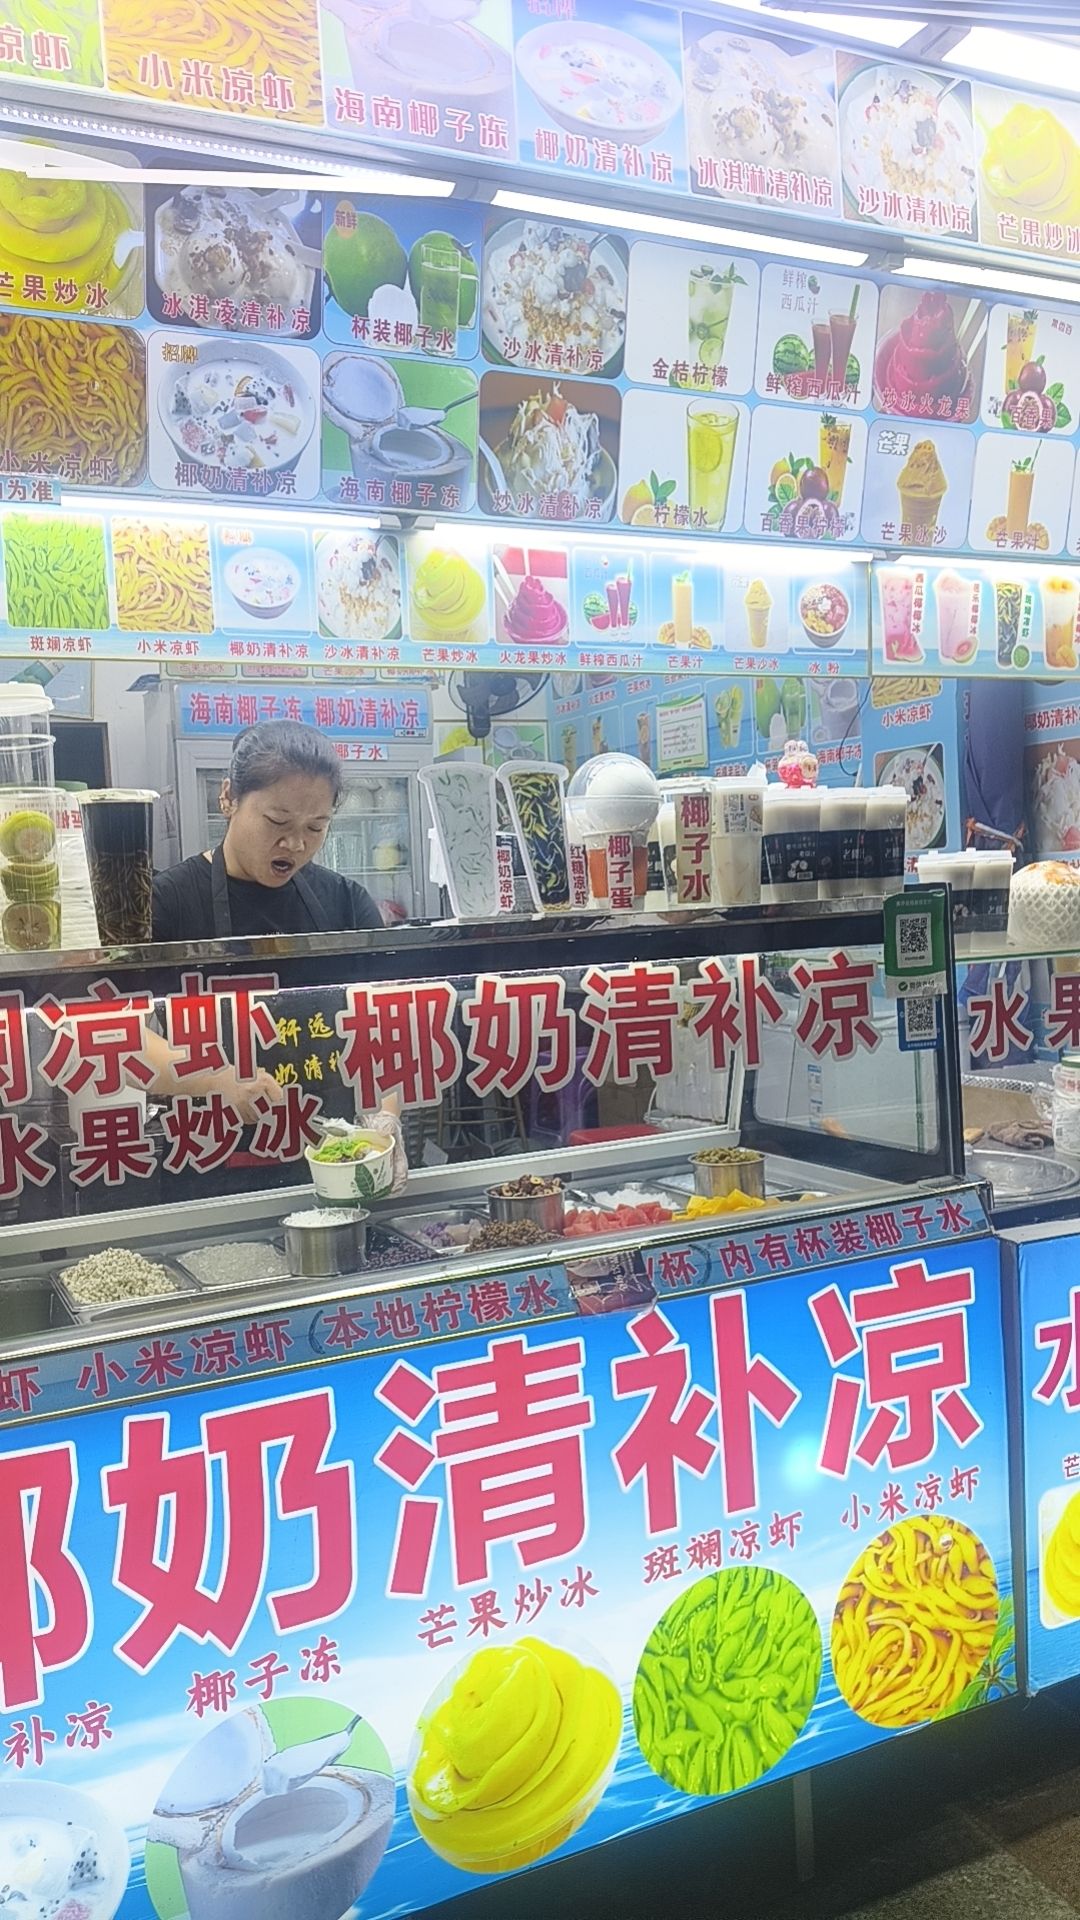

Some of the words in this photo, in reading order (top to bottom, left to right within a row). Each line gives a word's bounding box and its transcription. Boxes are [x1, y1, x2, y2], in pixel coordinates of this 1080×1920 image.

[139, 54, 295, 112] 小米凉虾
[334, 87, 510, 151] 海南椰子冻
[534, 127, 674, 184] 椰奶清补凉
[697, 156, 833, 208] 冰淇淋清补凉
[858, 185, 972, 233] 沙冰清补凉
[0, 271, 109, 309] 芒果炒冰
[781, 293, 818, 315] 西瓜汁
[162, 292, 312, 333] 冰淇凌清补凉
[352, 315, 454, 350] 杯装椰子水
[162, 342, 198, 364] 招牌
[503, 337, 605, 371] 沙冰清补凉
[652, 357, 729, 388] 金桔柠檬
[765, 371, 861, 404] 鲜榨西瓜汁
[882, 387, 970, 419] 炒冰火龙果
[1010, 404, 1054, 428] 百香果
[877, 430, 911, 456] 芒果
[0, 449, 114, 482] 小米凉虾
[175, 462, 297, 495] 椰奶清补凉
[0, 479, 54, 502] 为准
[339, 476, 462, 507] 海南椰子冻
[492, 491, 603, 519] 炒冰清补凉
[654, 503, 709, 527] 柠檬水
[760, 512, 846, 537] 百香果柠檬
[881, 521, 948, 545] 芒果冰沙
[995, 530, 1040, 550] 芒果汁
[29, 635, 93, 654] 斑斓凉虾
[137, 639, 200, 657] 小米凉虾
[229, 641, 309, 659] 椰奶清补凉
[324, 644, 400, 661] 沙冰清补凉
[422, 648, 479, 663] 芒果炒冰
[499, 651, 567, 666] 火龙果炒冰
[579, 653, 644, 668] 鲜榨西瓜汁
[668, 655, 704, 669] 芒果汁
[734, 656, 780, 670] 芒果沙冰
[190, 692, 303, 725] 海南椰子冻
[315, 695, 420, 728] 椰奶清补凉
[882, 702, 934, 728] 小米凉虾
[1024, 705, 1080, 731] 椰奶清补
[681, 795, 711, 901] 椰子水
[497, 849, 514, 909] 椰奶凉虾
[570, 844, 587, 905] 红糖凉虾
[608, 835, 634, 909] 椰子蛋
[341, 949, 881, 1110] 椰奶清补凉
[77, 1319, 293, 1398] 小米凉虾
[720, 1199, 972, 1278] 内有杯装椰子水
[841, 1466, 980, 1530] 小米凉虾
[643, 1511, 803, 1584] 斑斓凉虾
[417, 1568, 599, 1650] 芒果炒冰
[187, 1636, 342, 1719] 椰子冻
[3, 1703, 113, 1769] 补凉
